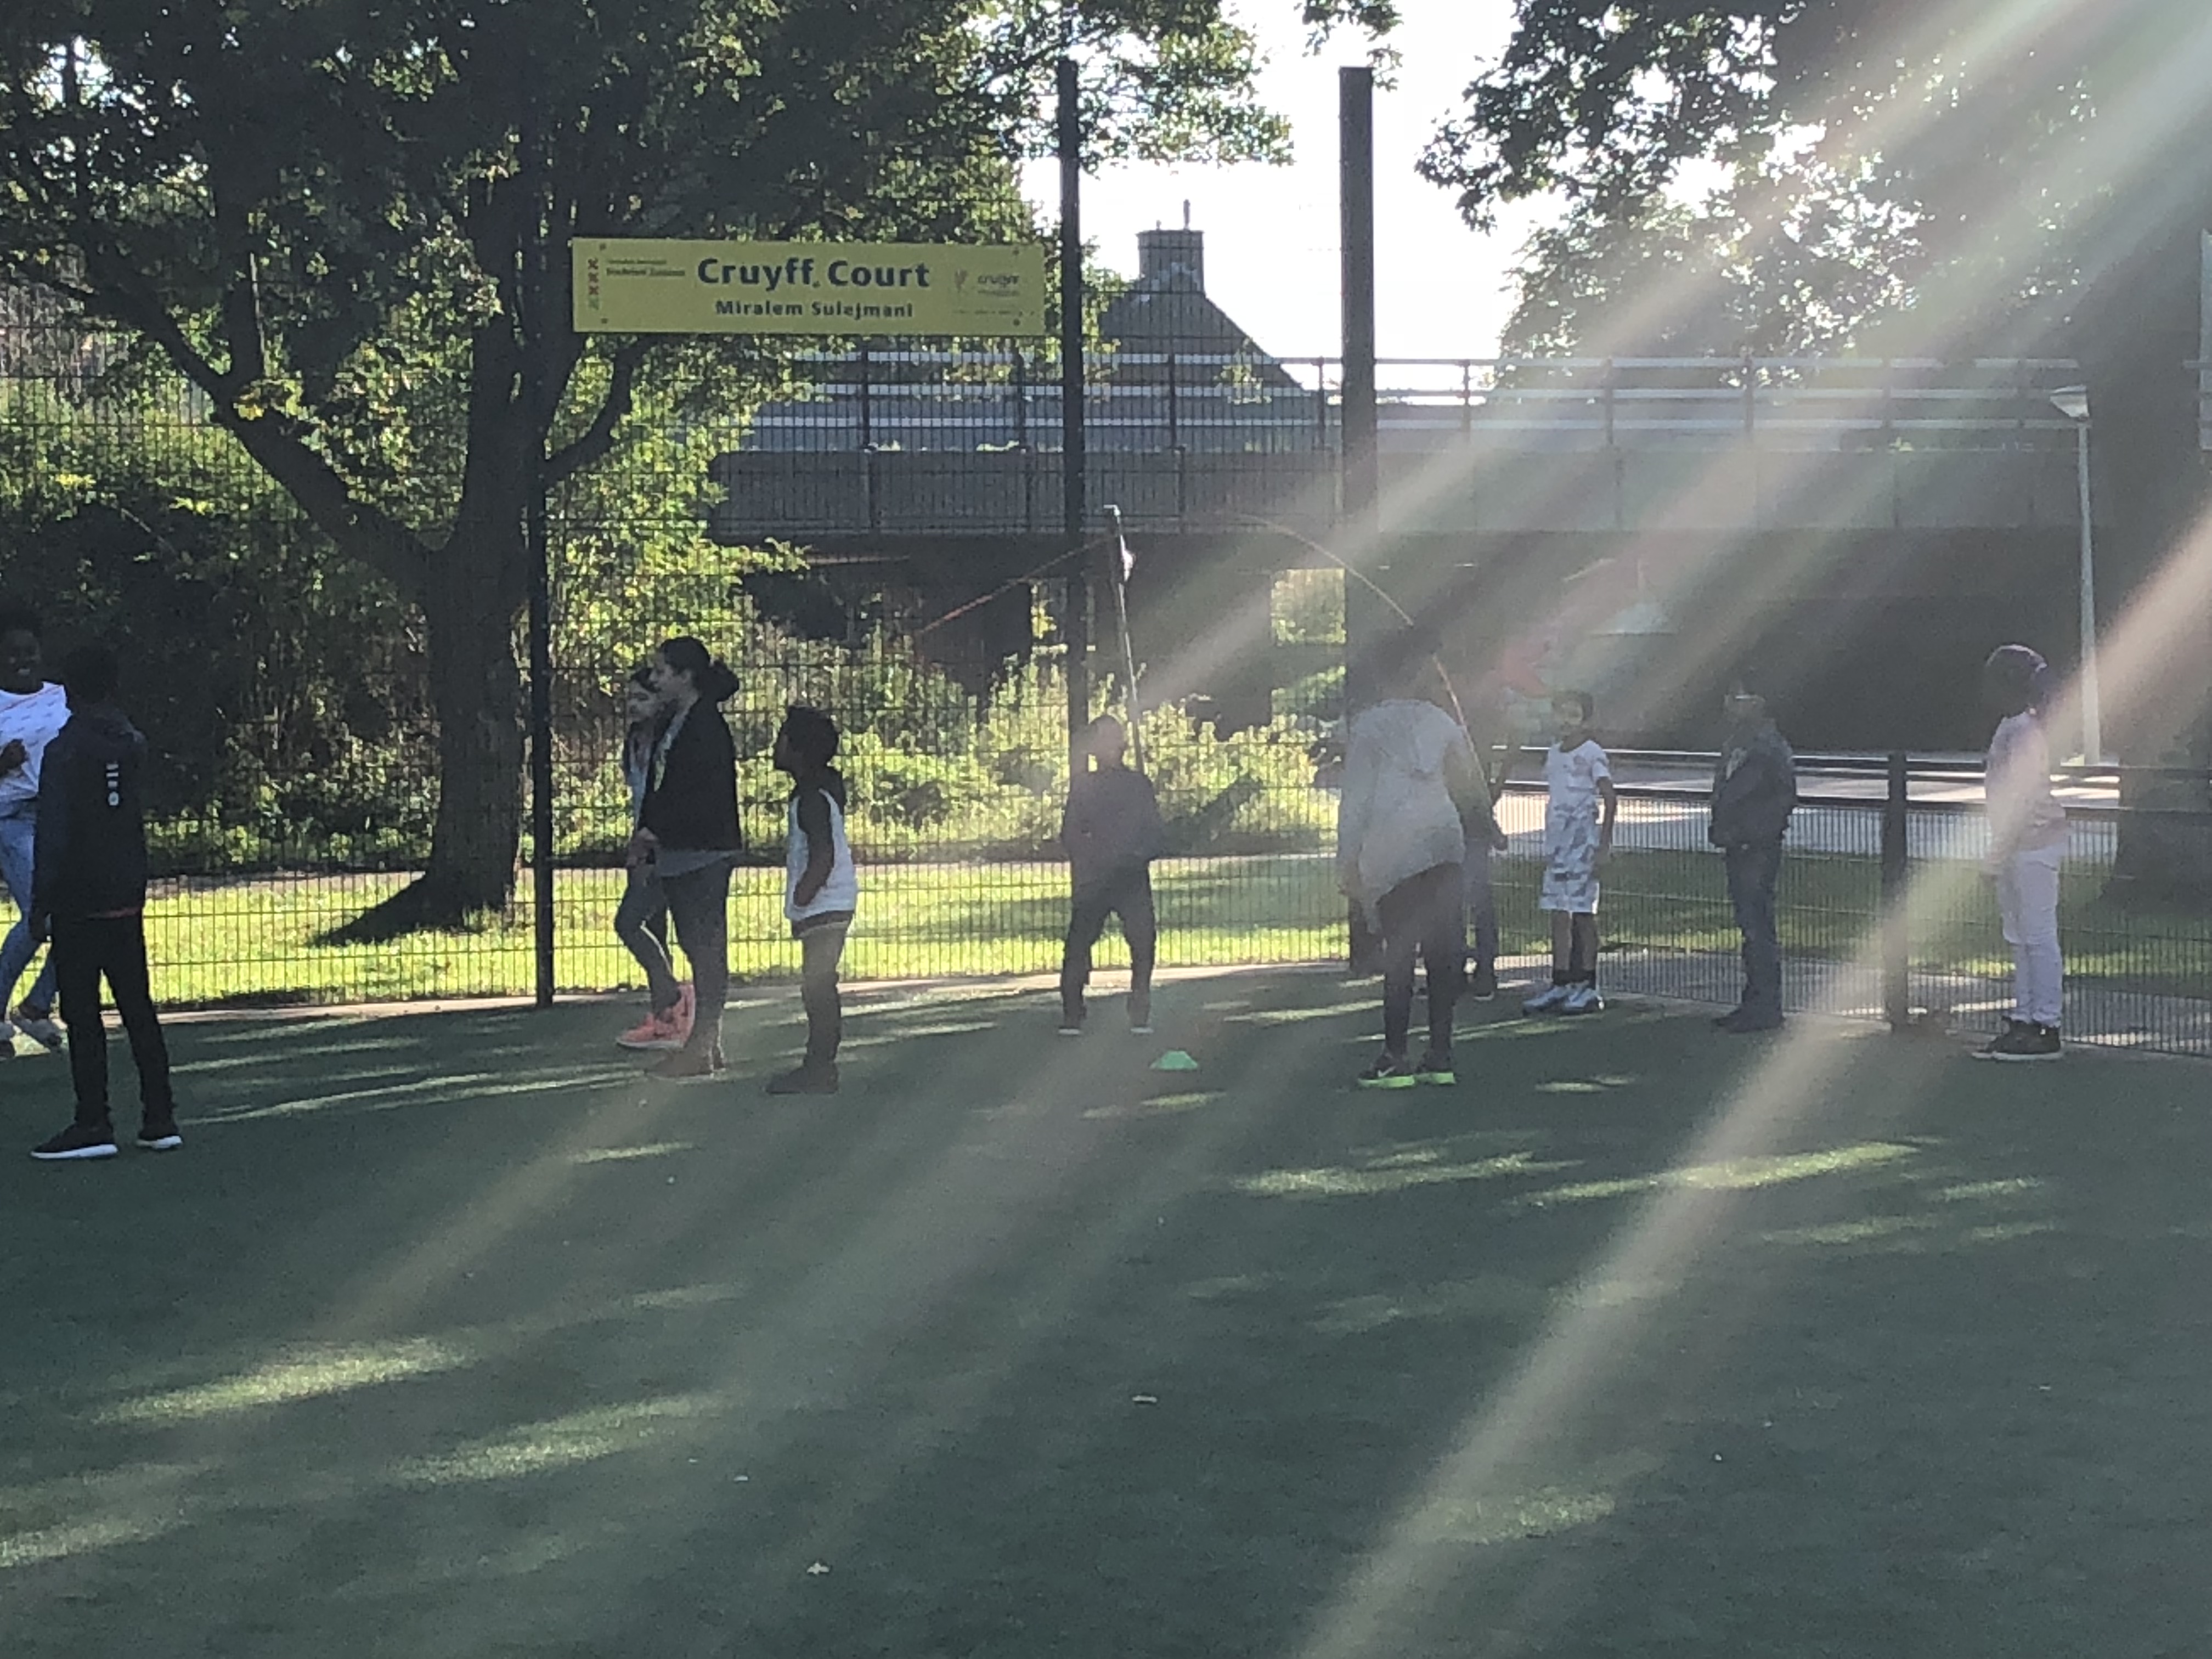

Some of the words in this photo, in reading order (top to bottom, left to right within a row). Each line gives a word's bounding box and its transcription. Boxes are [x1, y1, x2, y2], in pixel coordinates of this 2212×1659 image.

[698, 258, 815, 291] Cruyff
[827, 259, 930, 288] Court
[715, 300, 803, 315] Miralem
[811, 301, 913, 320] Sulejmani
